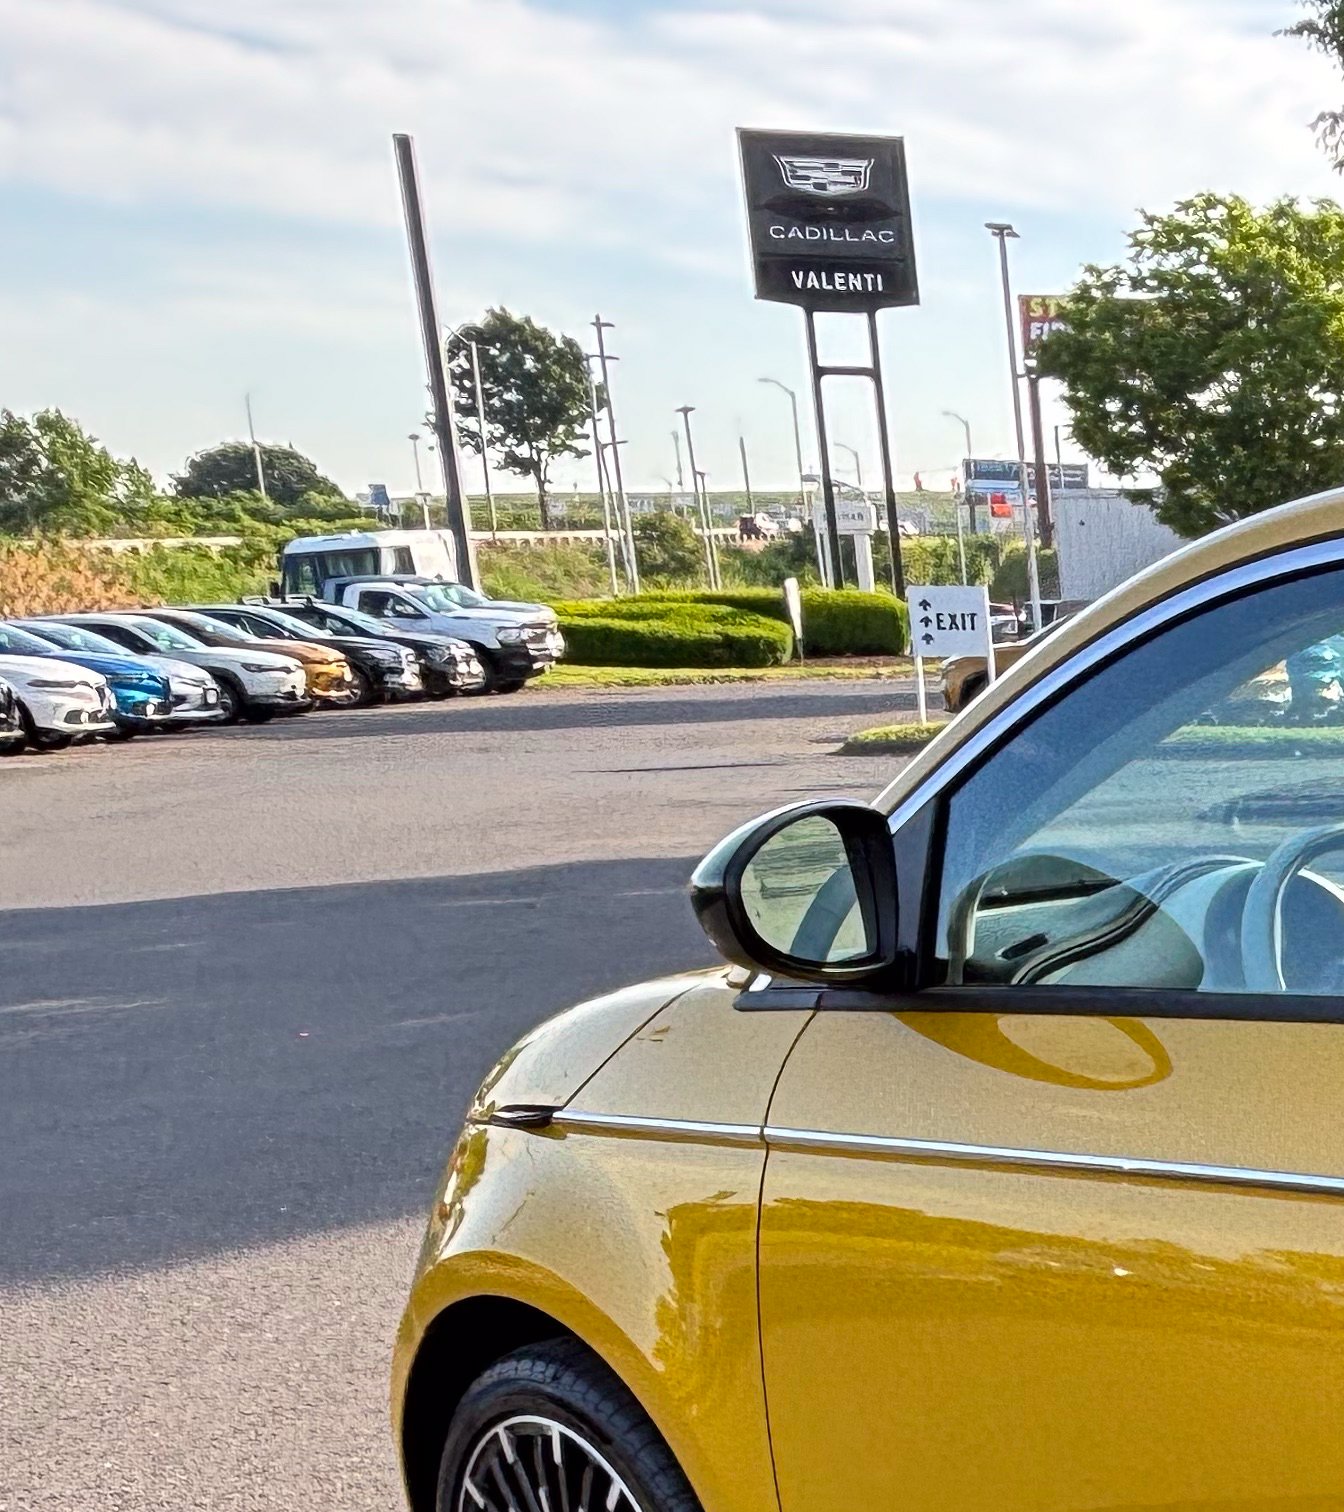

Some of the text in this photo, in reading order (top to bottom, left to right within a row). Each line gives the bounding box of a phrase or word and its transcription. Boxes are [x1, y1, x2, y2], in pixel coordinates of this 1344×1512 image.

[769, 225, 895, 243] CADILLAC
[791, 270, 884, 292] VALENTI
[936, 612, 978, 631] EXIT
